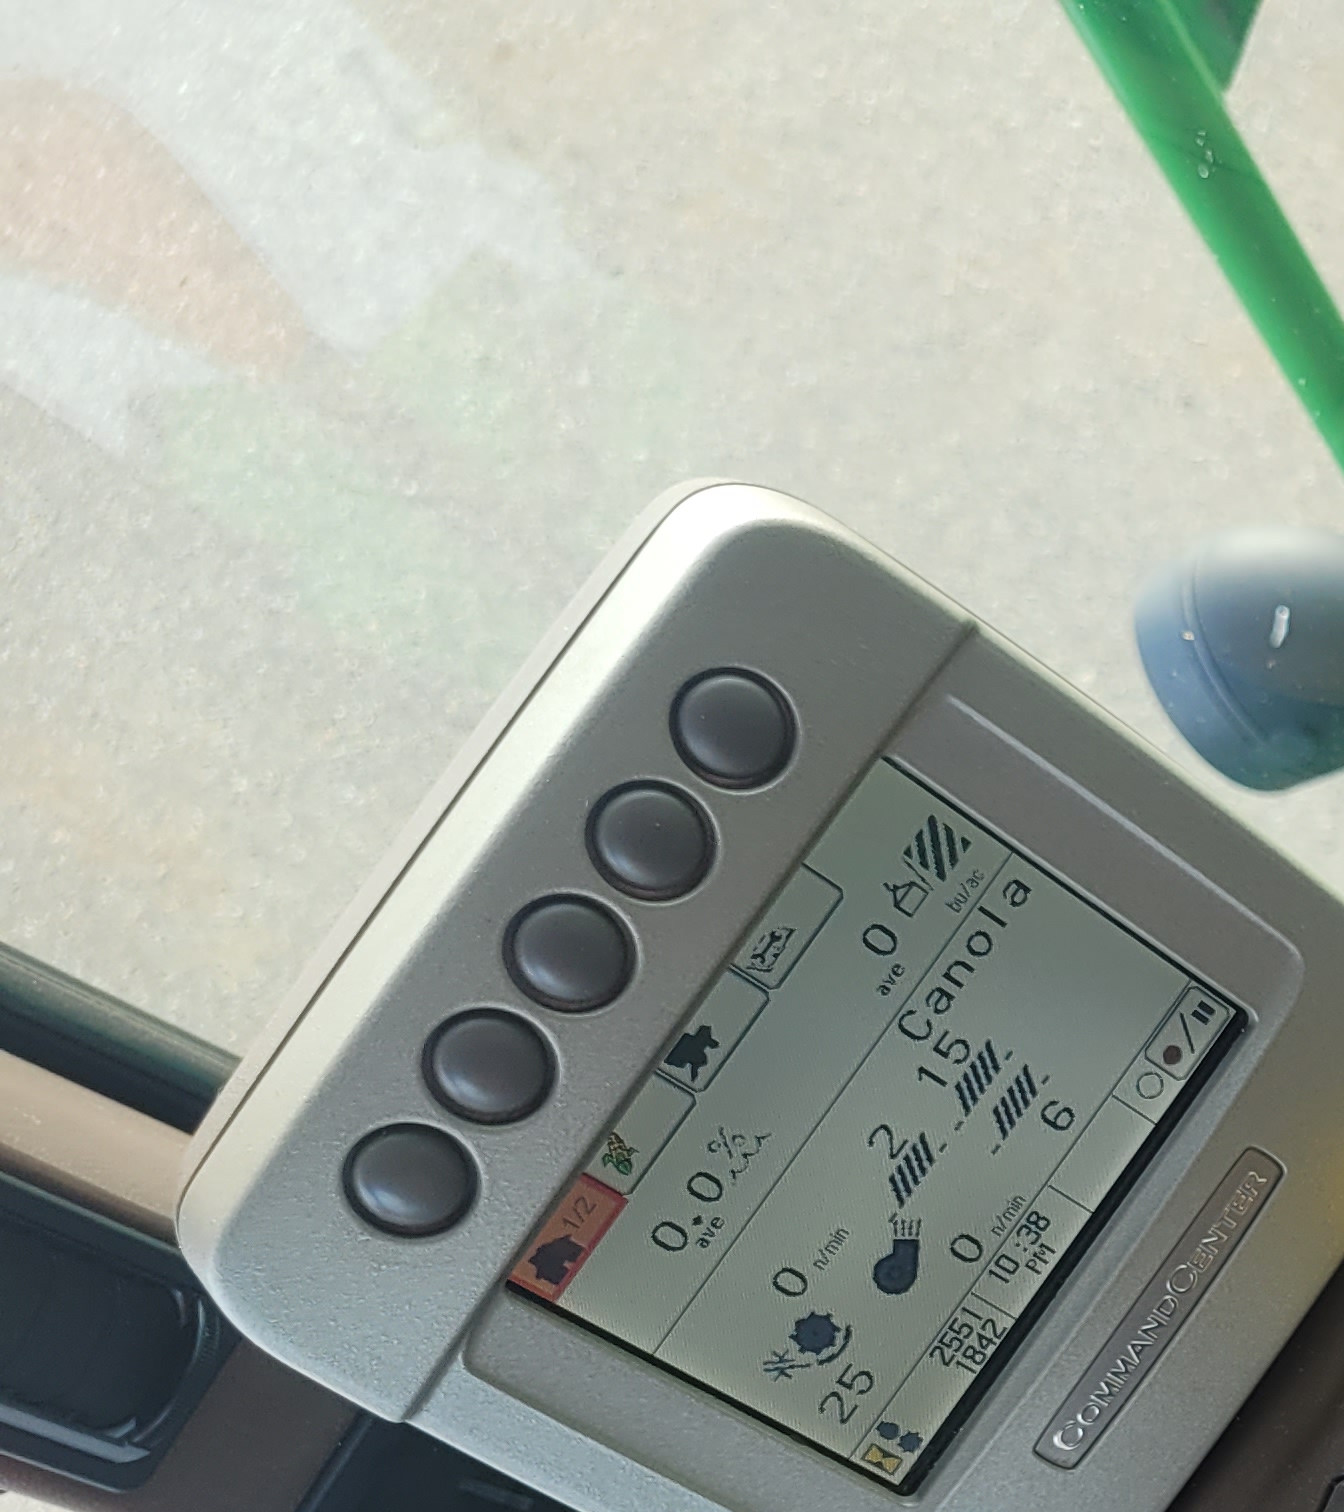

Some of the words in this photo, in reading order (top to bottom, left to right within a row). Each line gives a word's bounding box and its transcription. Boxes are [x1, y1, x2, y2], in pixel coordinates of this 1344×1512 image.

[862, 923, 898, 956] 0
[898, 878, 1032, 1041] Canola
[876, 962, 905, 997] ave
[917, 1030, 971, 1088] 15
[1040, 1100, 1076, 1131] 6
[867, 1123, 909, 1160] 2
[562, 1195, 597, 1231] 1/2
[651, 1171, 723, 1252] 0.0
[695, 1215, 725, 1249] ave
[950, 1233, 984, 1264] 0
[988, 1210, 1051, 1284] 10:38
[1025, 1242, 1056, 1275] PM
[772, 1266, 808, 1297] 0
[1053, 1170, 1268, 1451] COMMANDCENTER
[929, 1306, 984, 1368] 2551
[955, 1317, 1008, 1375] 1842
[818, 1363, 875, 1425] 25
